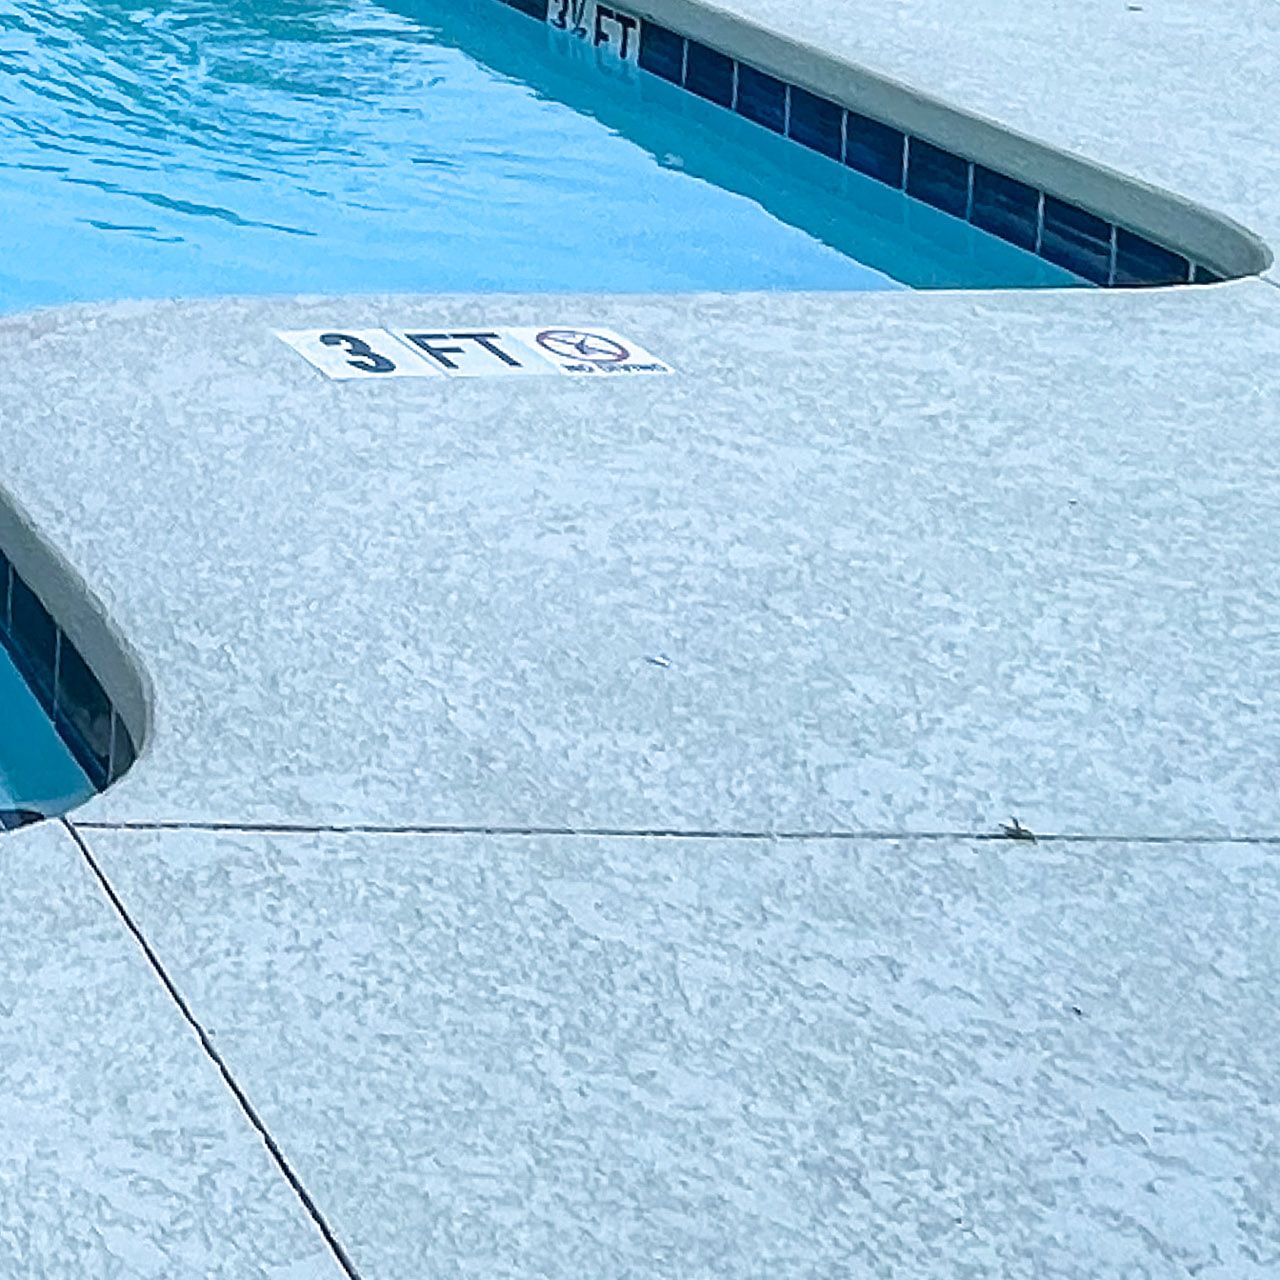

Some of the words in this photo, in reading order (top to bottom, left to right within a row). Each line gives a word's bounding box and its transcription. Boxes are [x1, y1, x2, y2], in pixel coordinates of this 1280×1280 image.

[593, 4, 638, 60] FT
[319, 333, 397, 374] 3
[404, 331, 523, 370] FT
